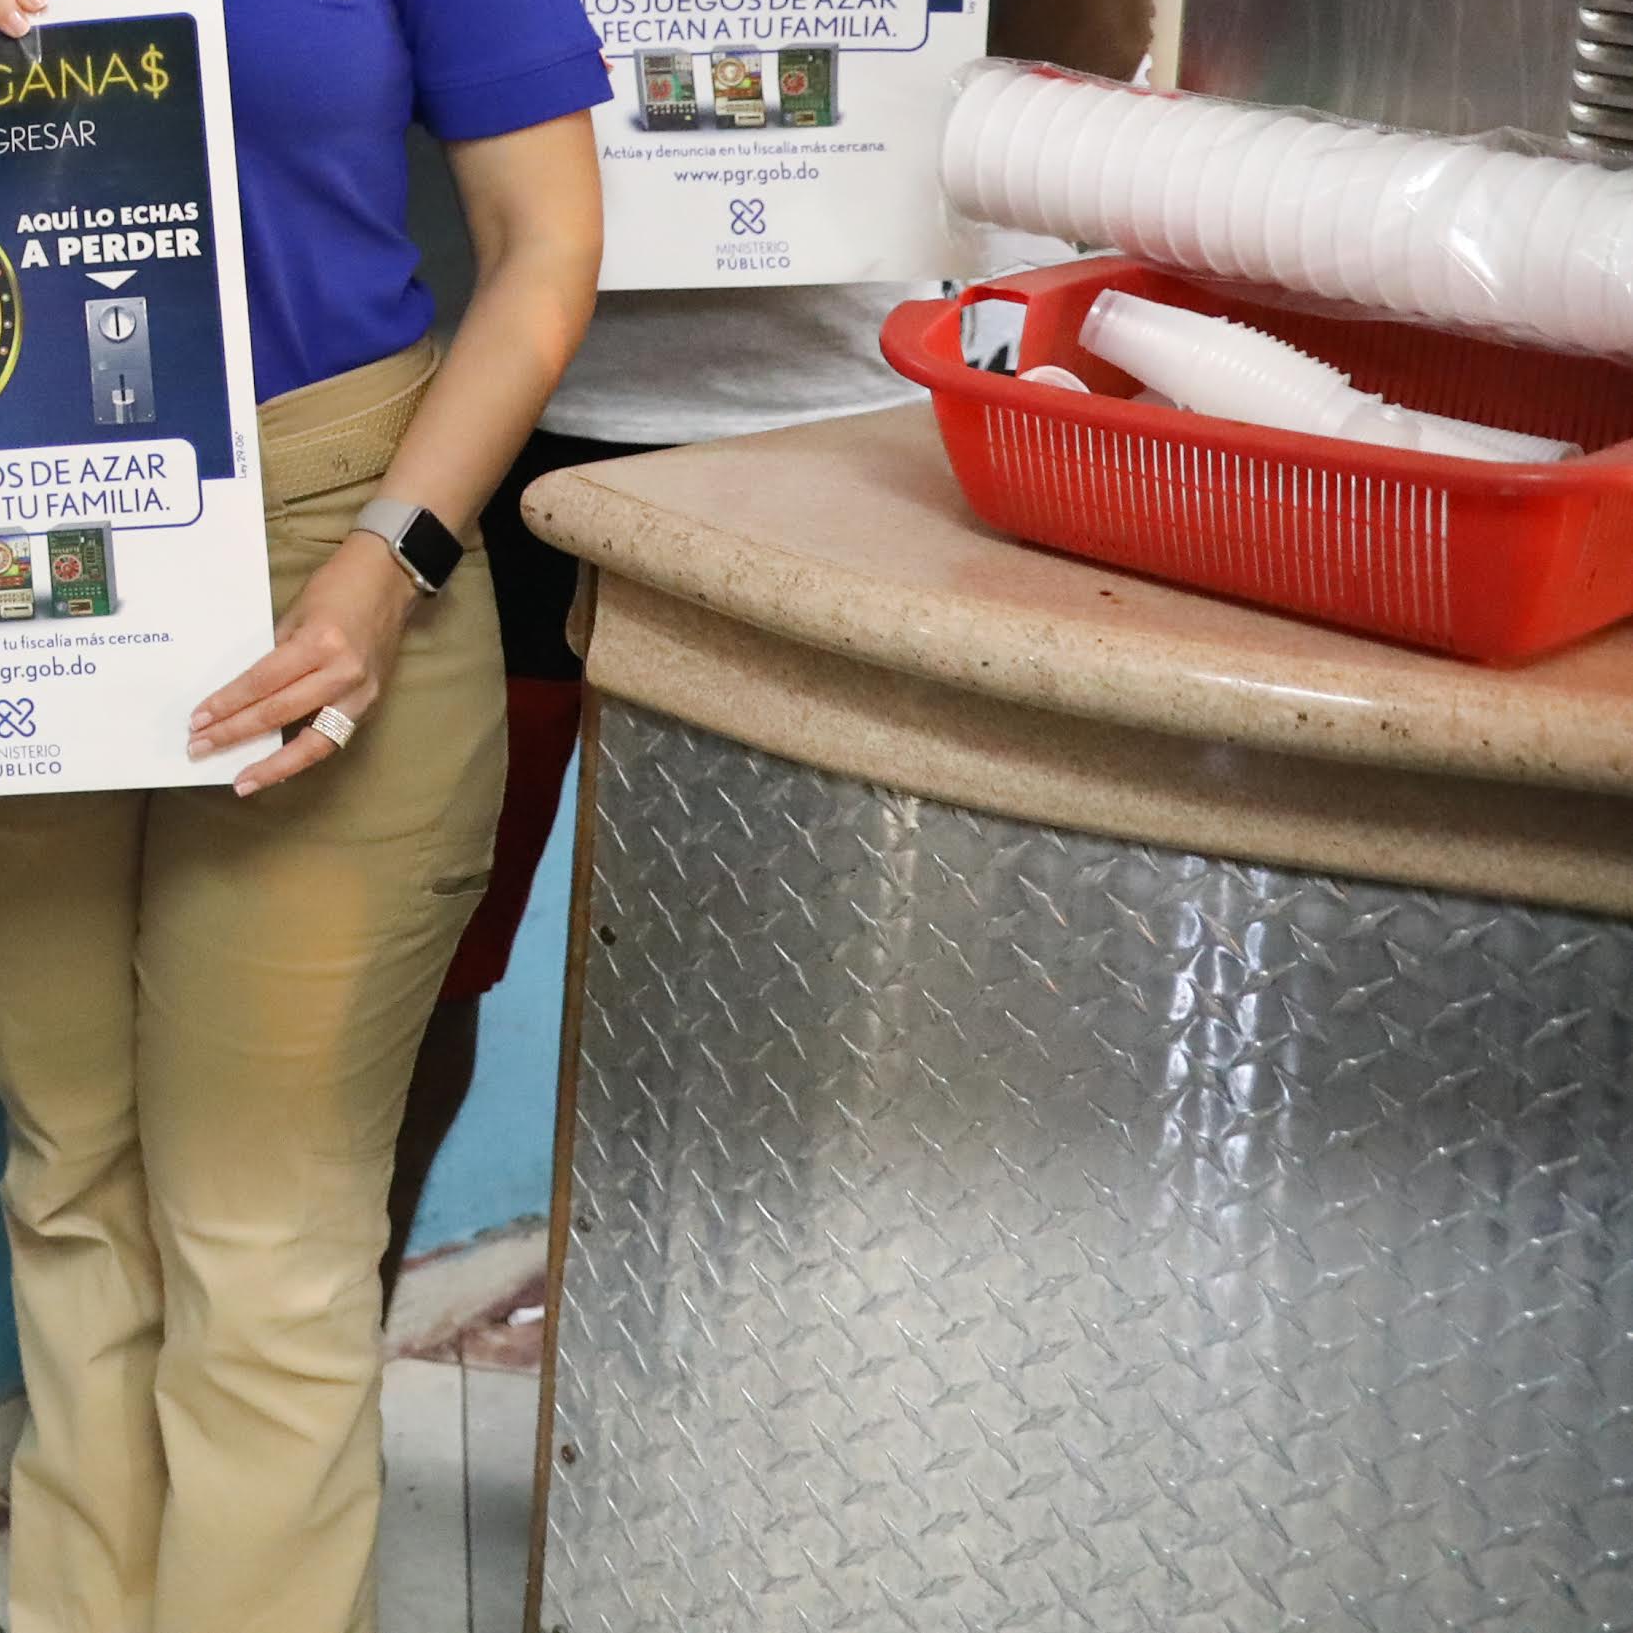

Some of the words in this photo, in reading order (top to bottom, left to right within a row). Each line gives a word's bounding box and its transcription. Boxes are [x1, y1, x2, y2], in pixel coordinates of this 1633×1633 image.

[603, 18, 706, 43] FECTAN
[713, 18, 732, 40] A
[738, 16, 773, 39] TU
[780, 15, 897, 38] FAMILIA.
[673, 160, 820, 186] www.pgr.gob.do
[16, 205, 79, 234] AQUÍ
[83, 207, 115, 229] LO
[119, 201, 199, 226] ECHAS
[20, 238, 50, 269] A
[57, 227, 202, 266] PERDER
[30, 458, 72, 487] DE
[79, 452, 167, 484] AZAR
[0, 493, 38, 521] TU
[46, 486, 170, 518] FAMILIA.
[2, 638, 18, 651] tu
[20, 632, 72, 649] fiscalía
[74, 632, 105, 646] más
[108, 632, 173, 646] cercana.
